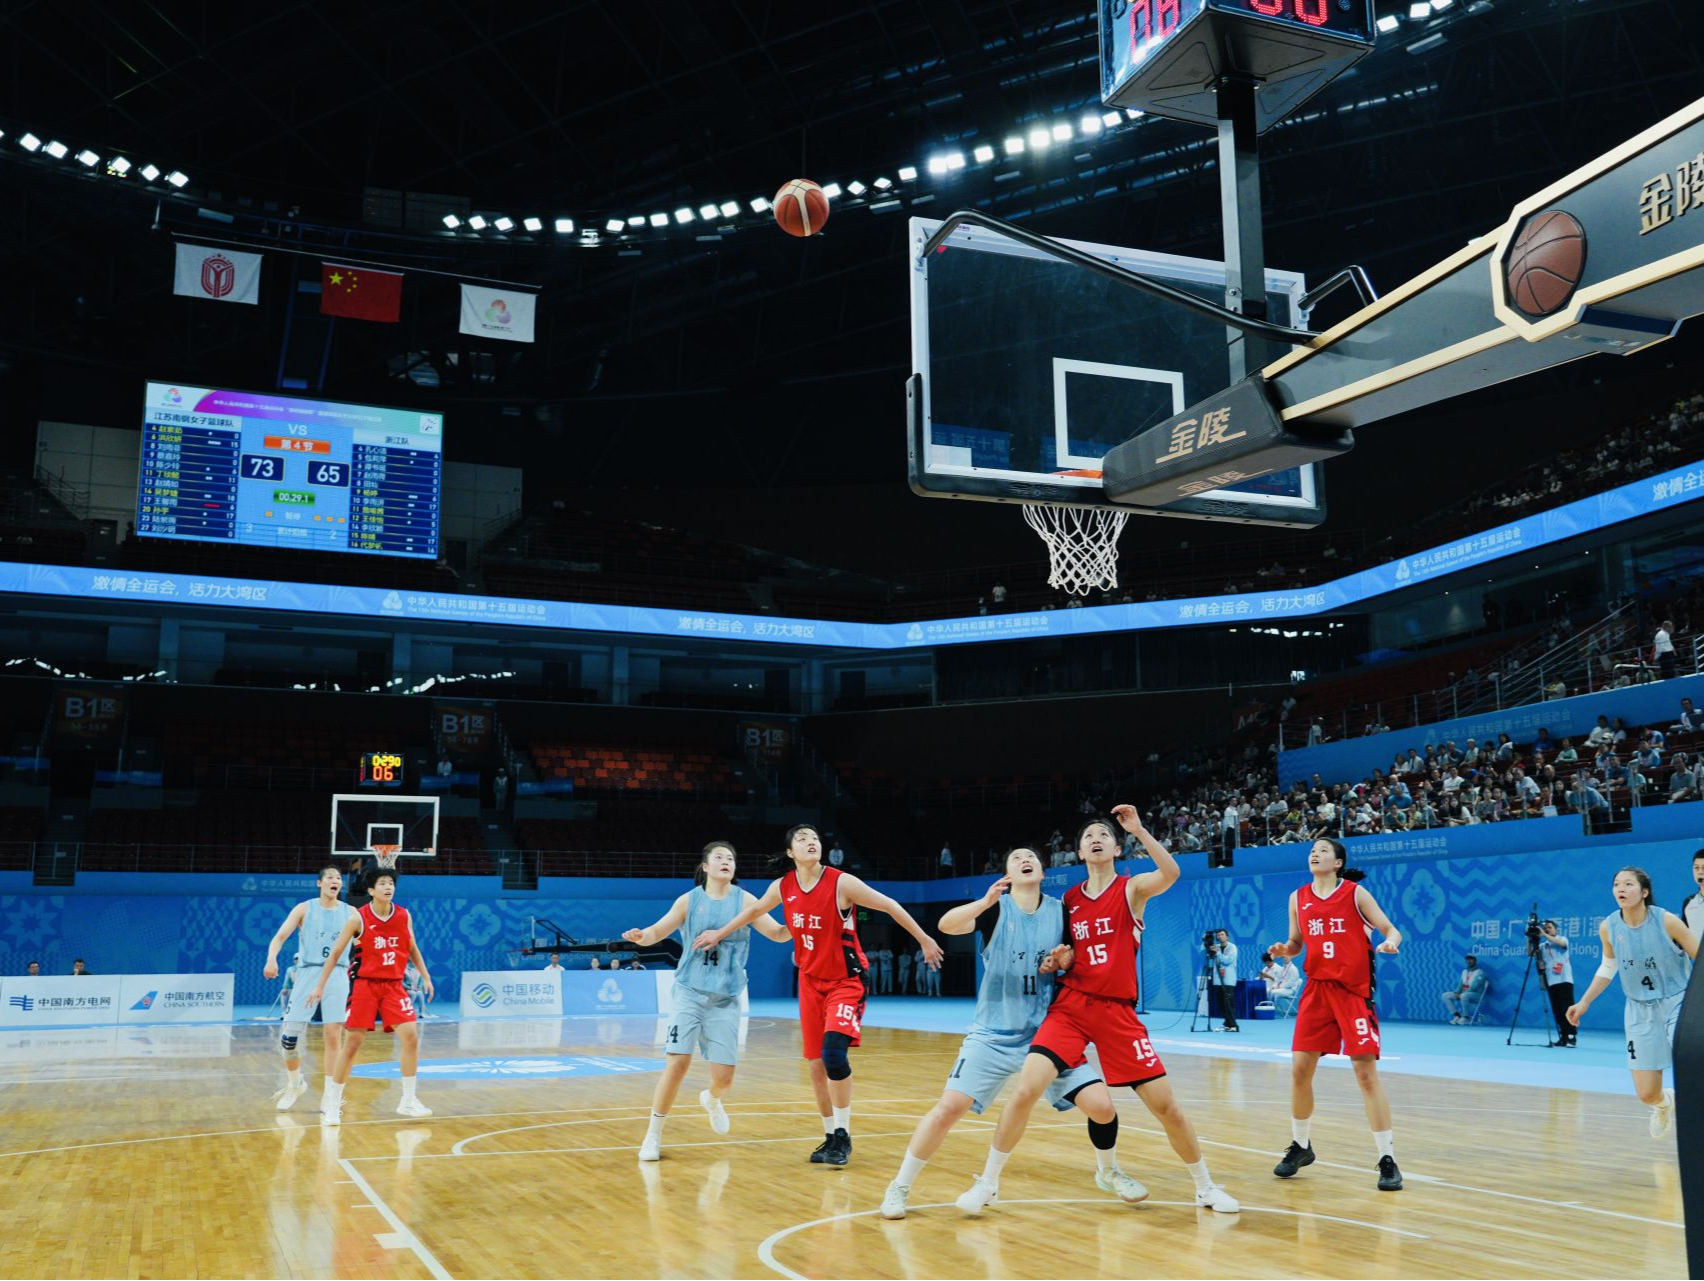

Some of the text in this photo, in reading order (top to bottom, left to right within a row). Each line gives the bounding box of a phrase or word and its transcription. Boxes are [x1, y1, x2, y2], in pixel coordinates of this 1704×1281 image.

[288, 423, 308, 435] VS
[1156, 407, 1246, 464] 金陵
[251, 458, 274, 477] 73
[316, 465, 340, 483] 65
[279, 492, 309, 503] 00:29.1
[330, 530, 337, 540] 2
[1412, 527, 1521, 570] 中华人民共和国第十五届运动会
[407, 596, 546, 615] 中华人民共和国第十五届运动会
[927, 616, 1049, 633] 中华人民共和国第十五届运动会
[65, 697, 117, 718] B1区
[442, 714, 485, 733] B1区
[373, 766, 393, 781] 06
[1350, 836, 1446, 854] 中华人民共和国第十五届运动会
[792, 912, 822, 929] 浙江
[1072, 916, 1114, 940] 浙江
[1307, 917, 1346, 936] 浙江
[374, 936, 399, 949] 浙江
[1322, 941, 1335, 959] 9
[1571, 942, 1600, 958] Hong
[322, 946, 331, 959] 6
[382, 951, 396, 966] 12
[703, 950, 719, 967] 14
[1086, 943, 1108, 966] 15
[502, 983, 554, 996] 中国移动
[1022, 975, 1037, 995] 11
[1641, 975, 1655, 990] 4
[38, 996, 111, 1007] 中国南方电网
[164, 991, 225, 1001] 中国南方航空
[400, 997, 414, 1012] 12
[503, 996, 554, 1006] China Mobile
[836, 1003, 855, 1020] 16
[1355, 1017, 1369, 1036] 9
[1132, 1038, 1155, 1060] 15
[1627, 1040, 1637, 1060] 4
